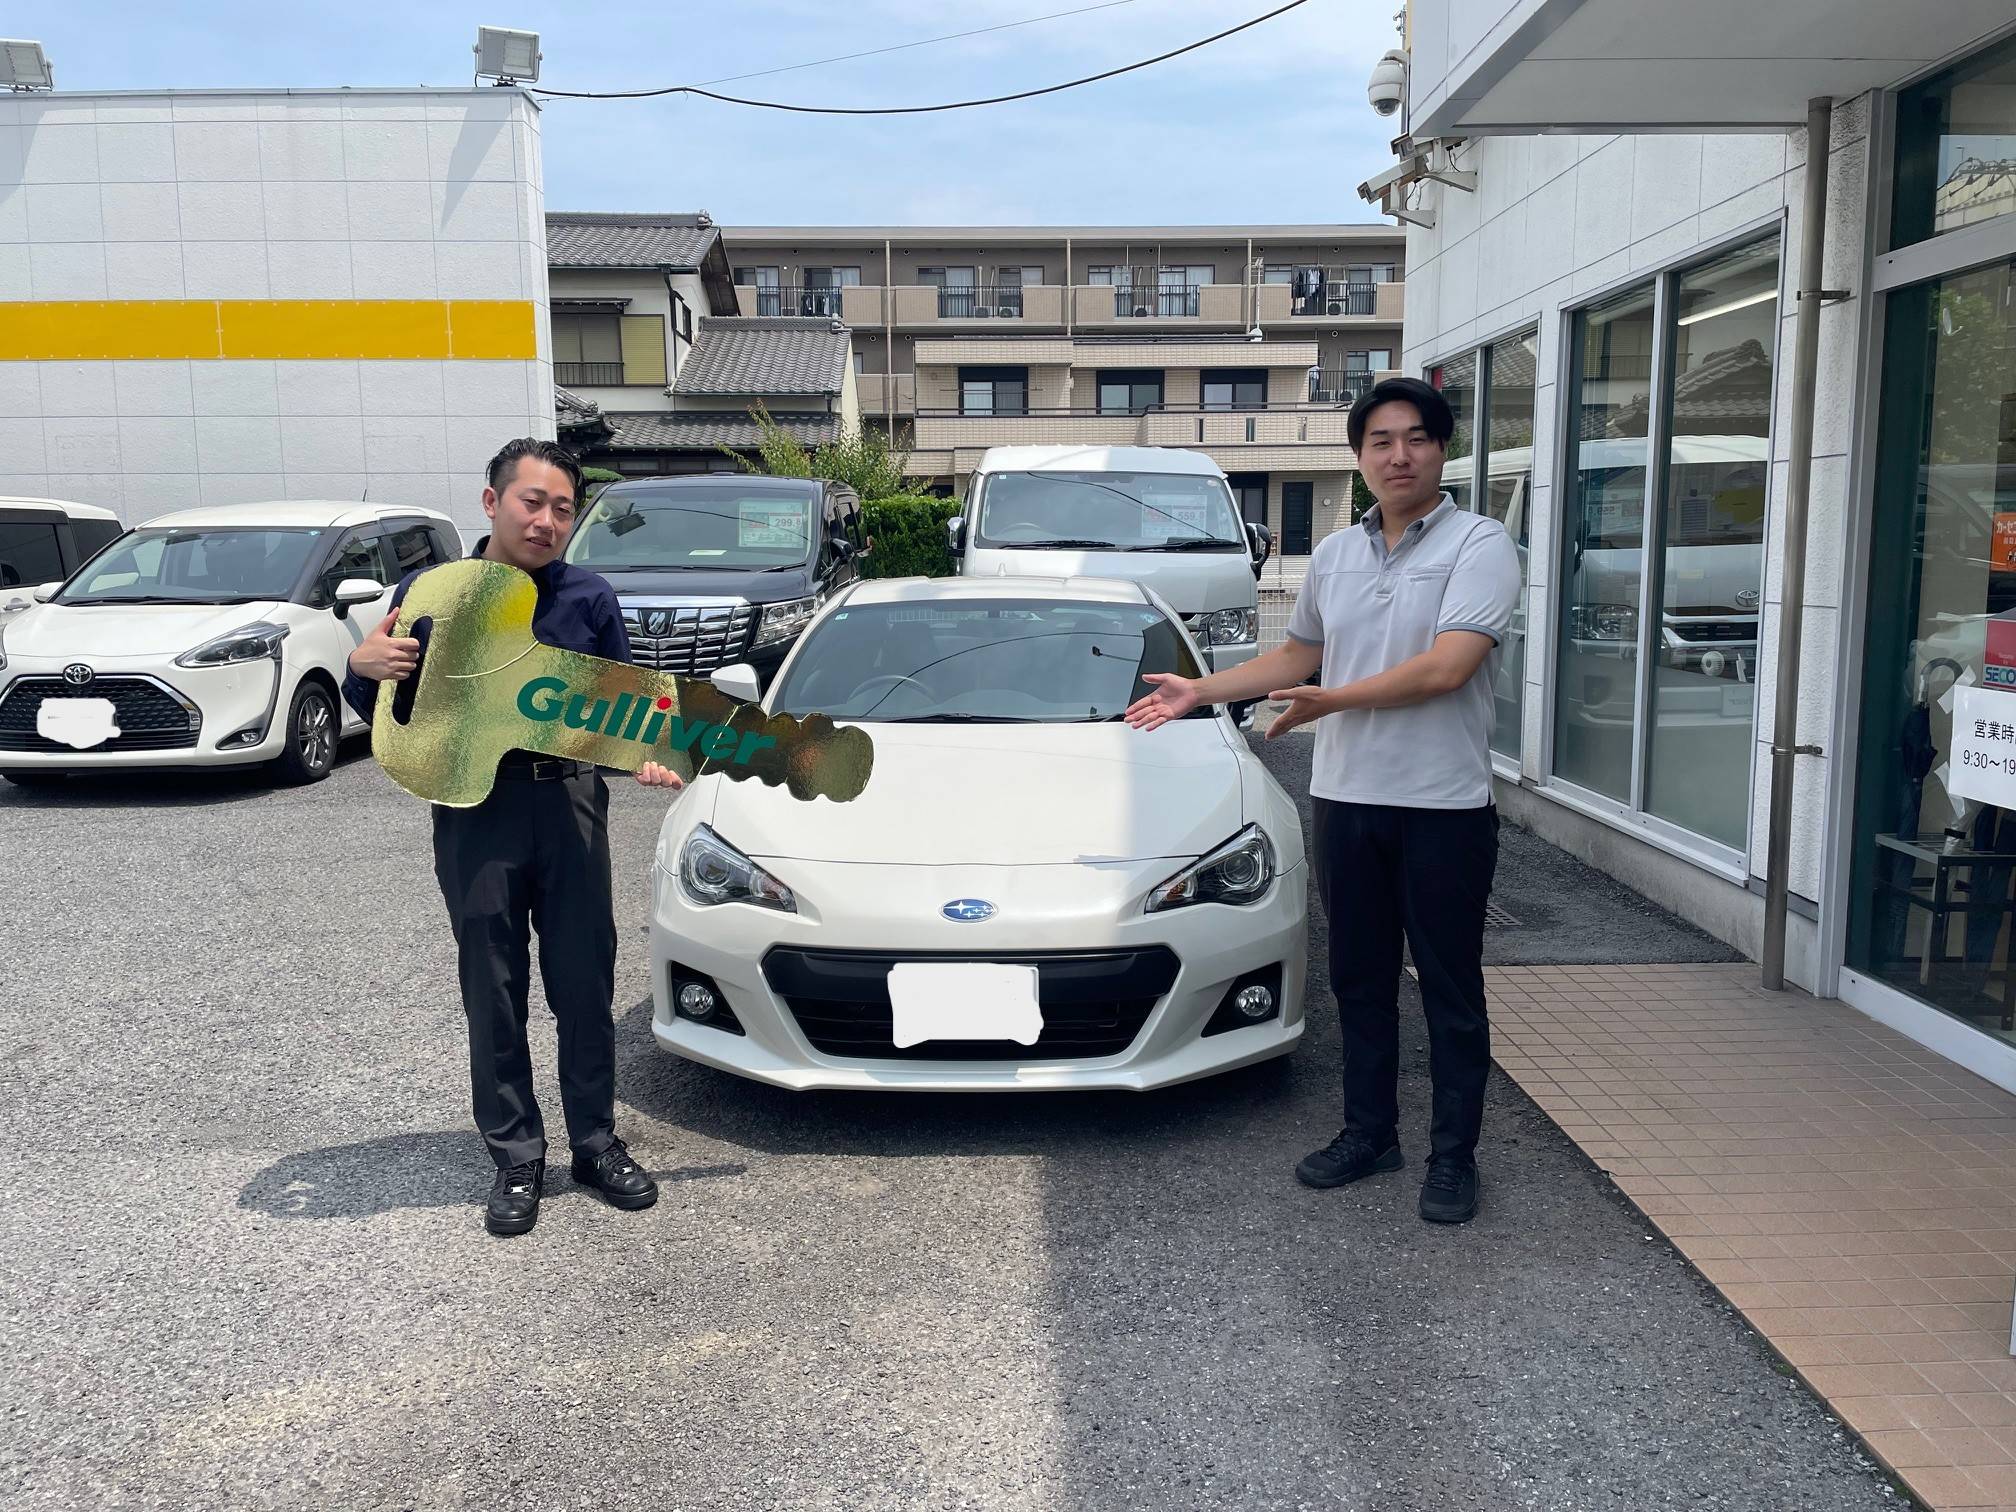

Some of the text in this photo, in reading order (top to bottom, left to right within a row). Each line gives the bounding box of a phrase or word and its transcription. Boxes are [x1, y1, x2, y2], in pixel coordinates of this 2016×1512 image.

[516, 676, 777, 766] Gulliver
[1974, 718, 2016, 744] 営業時
